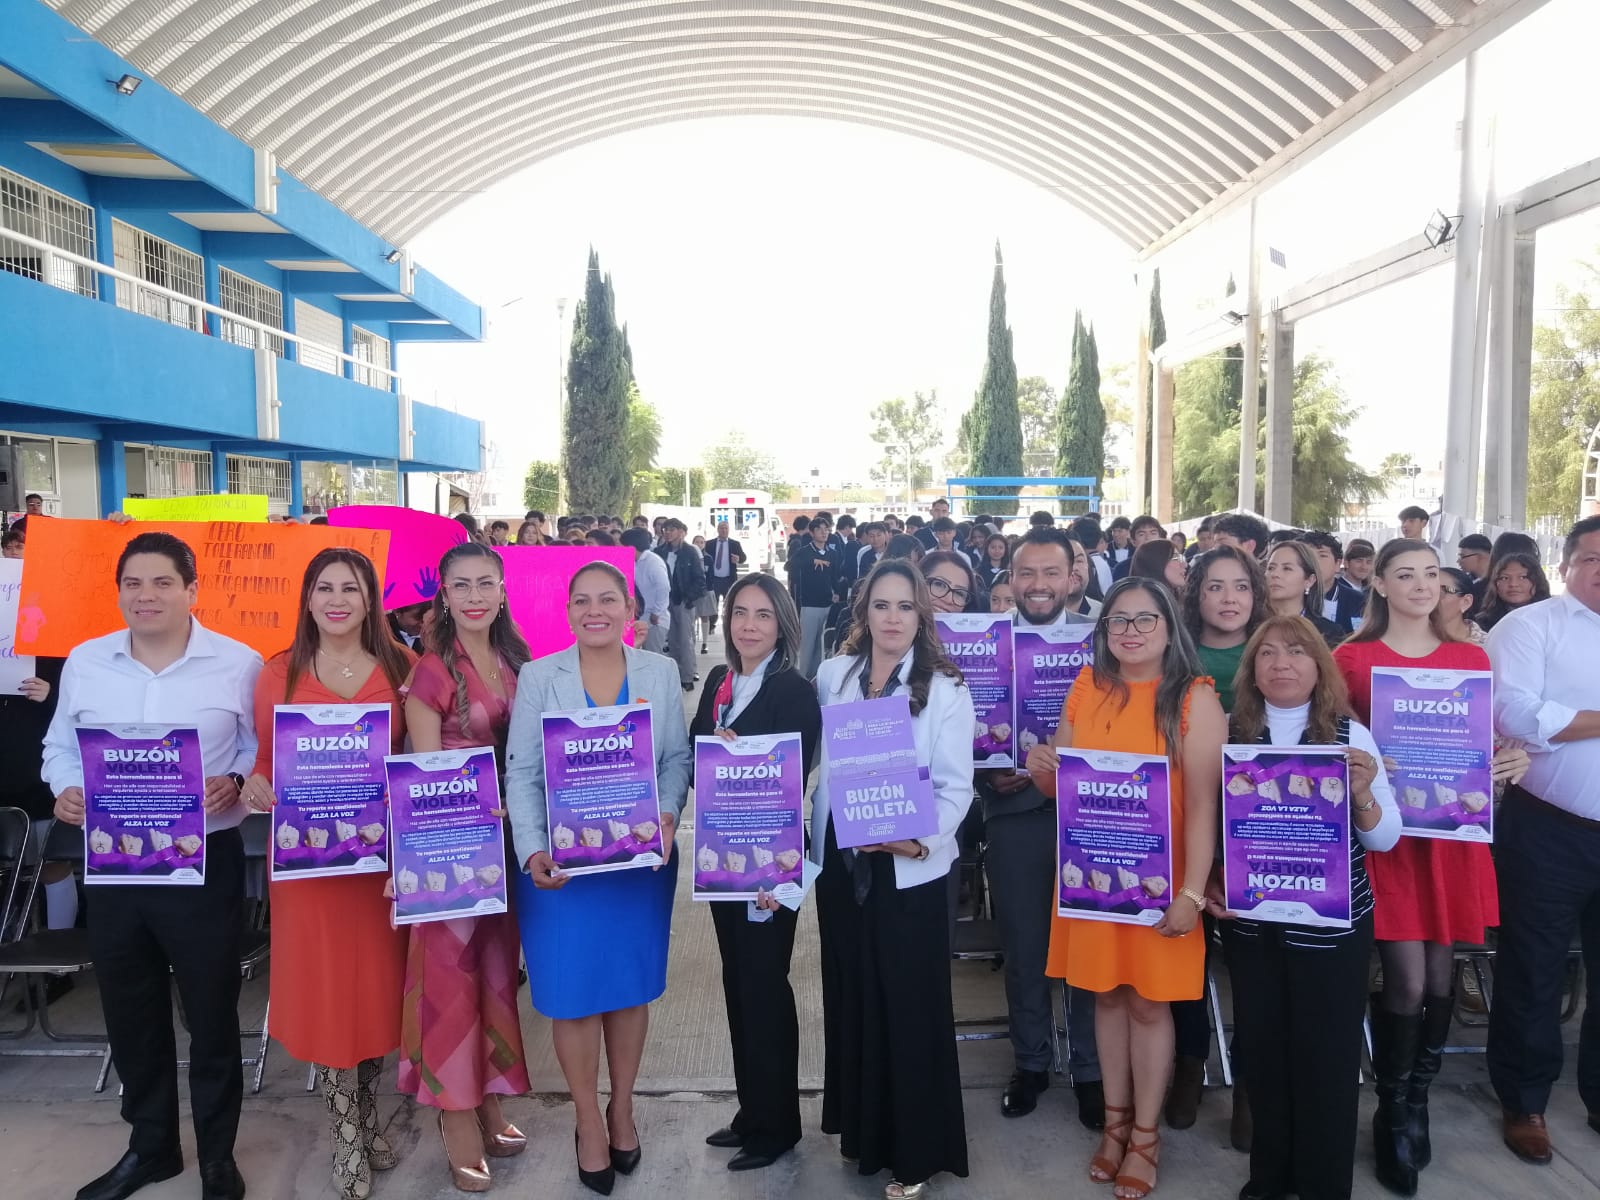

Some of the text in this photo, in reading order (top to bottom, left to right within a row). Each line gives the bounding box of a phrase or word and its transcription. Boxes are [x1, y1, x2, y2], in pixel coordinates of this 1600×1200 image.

[208, 522, 246, 541] CERO
[227, 594, 236, 608] Y
[1033, 650, 1094, 667] BUZÓN
[1393, 698, 1469, 716] BUZÓN
[1394, 714, 1468, 727] VIOLETA
[296, 733, 369, 752] BUZÓN
[564, 733, 633, 754] BUZÓN
[103, 746, 180, 763] BUZÓN
[297, 751, 368, 763] VIOLETA
[566, 751, 634, 766] VIOLETA
[106, 763, 180, 773] VIOLETA
[715, 762, 782, 779] BUZÓN
[409, 776, 478, 798] BUZÓN
[716, 779, 782, 791] VIOLETA
[846, 780, 905, 804] BUZÓN
[1077, 781, 1148, 800] BUZÓN
[411, 793, 478, 810] VIOLETA
[1079, 797, 1148, 811] VIOLETA
[844, 800, 917, 822] VIOLETA
[1249, 862, 1325, 875] VIOLETA
[1248, 873, 1326, 892] BUZÓN
